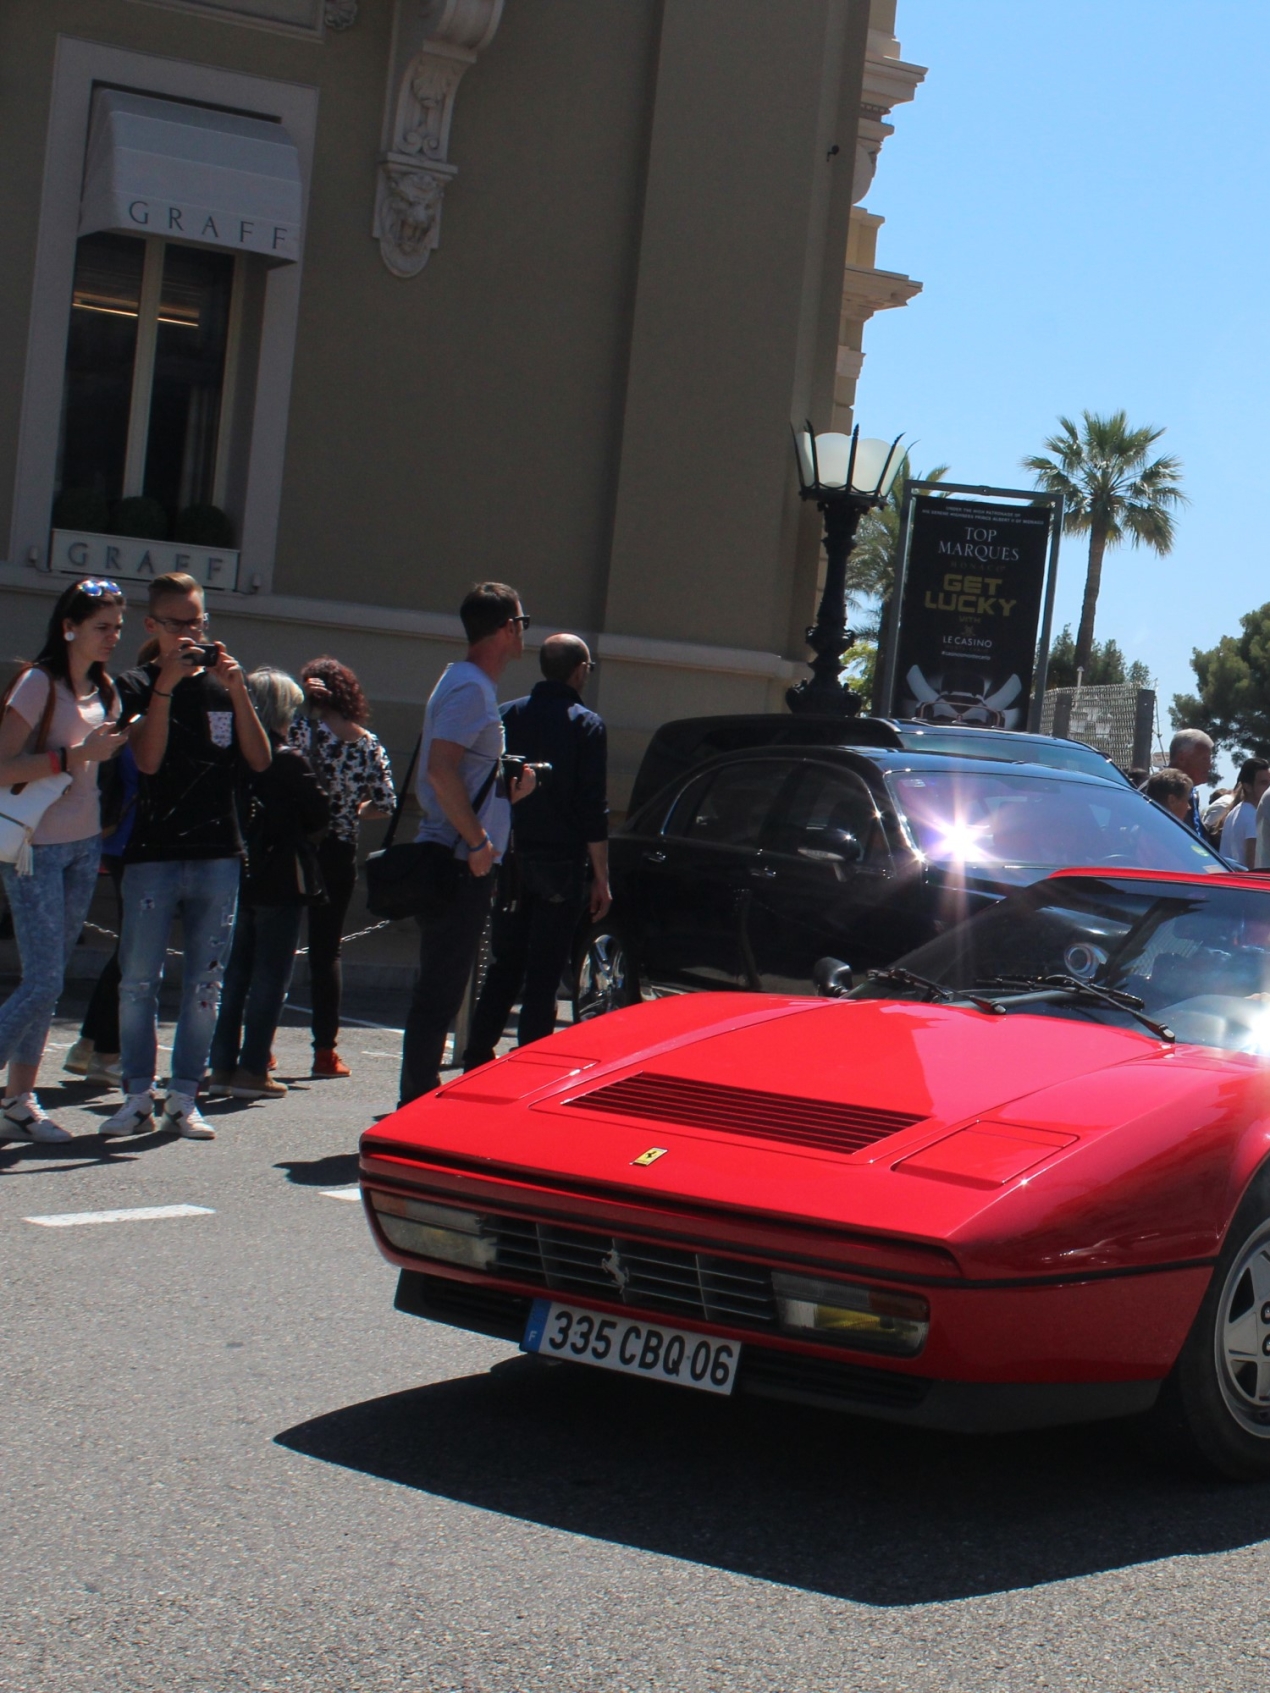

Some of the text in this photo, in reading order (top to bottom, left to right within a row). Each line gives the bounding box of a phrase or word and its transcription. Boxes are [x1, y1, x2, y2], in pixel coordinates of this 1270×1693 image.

[128, 199, 288, 250] GRAFF
[965, 527, 997, 542] TOP
[68, 541, 225, 581] GRAFF
[938, 540, 1019, 562] MARQUES
[943, 573, 1003, 596] GET
[924, 591, 1017, 616] LUCKY
[942, 635, 993, 648] LE CASINO
[528, 1330, 538, 1342] F
